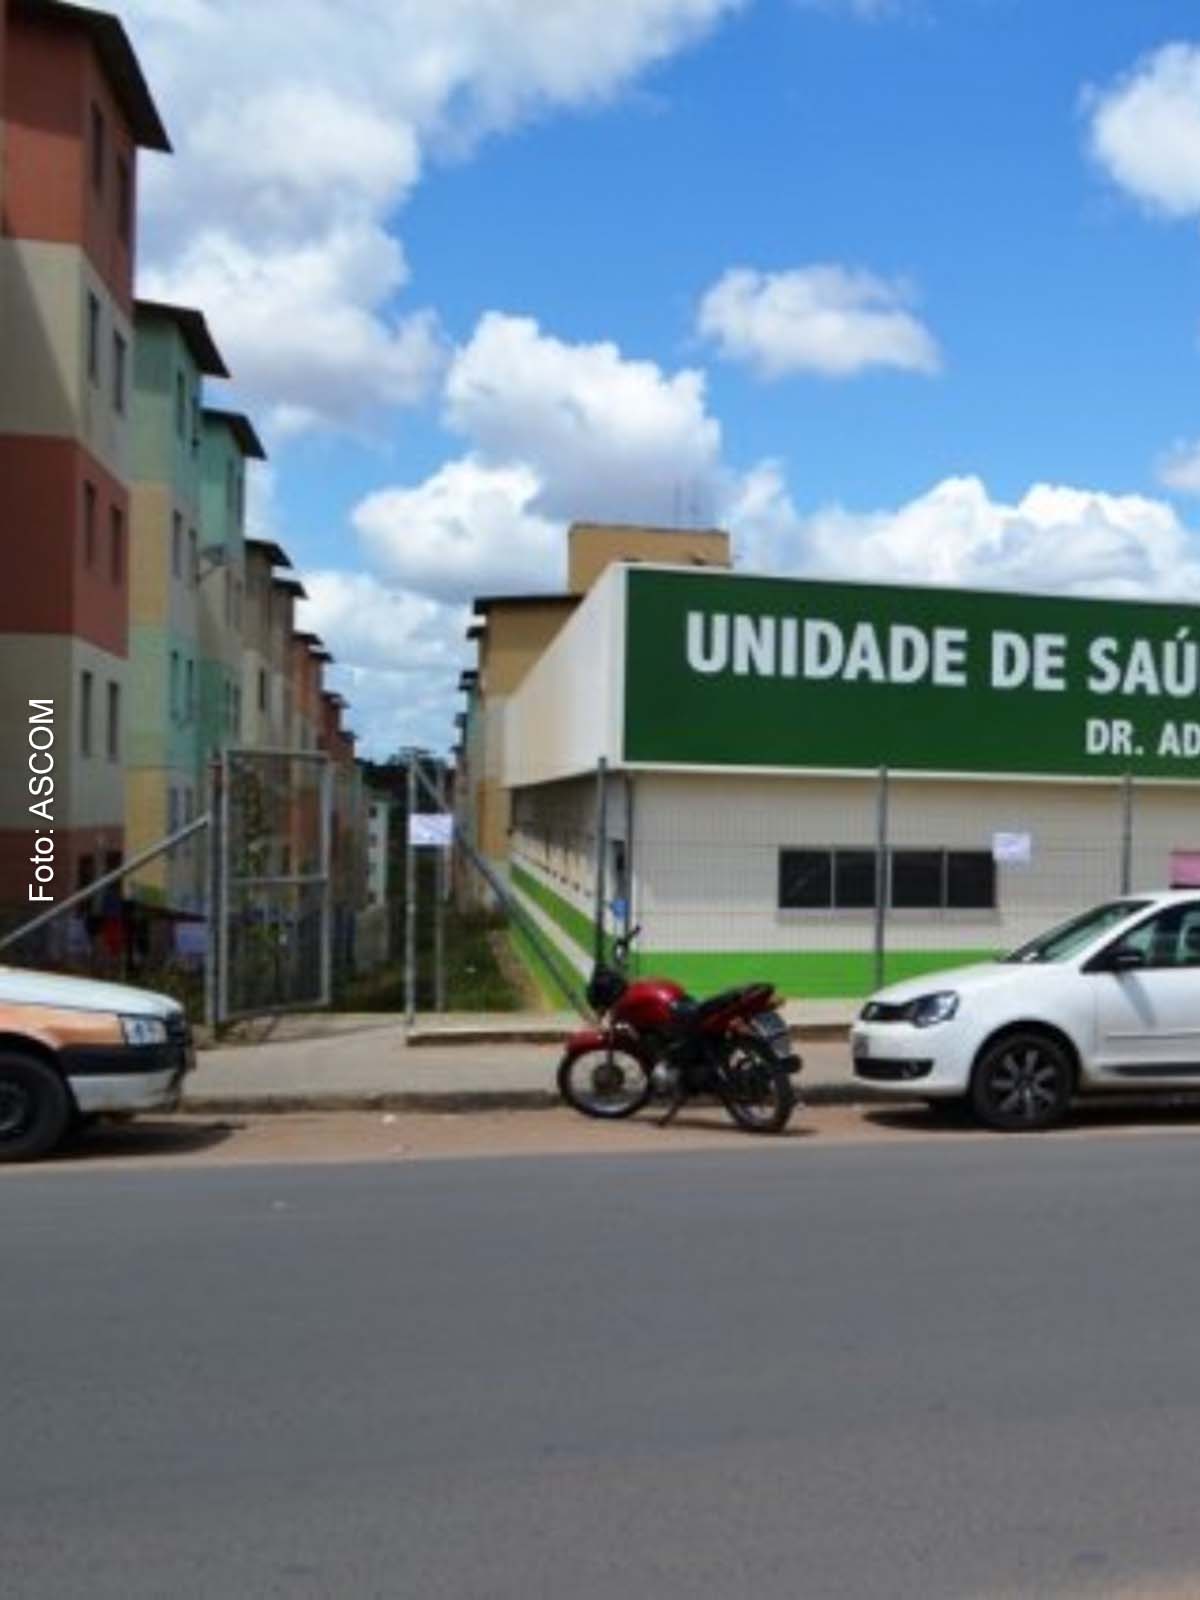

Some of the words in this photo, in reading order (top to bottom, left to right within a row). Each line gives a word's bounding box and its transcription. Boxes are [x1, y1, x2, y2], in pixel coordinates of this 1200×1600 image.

[687, 612, 968, 686] UNIDADE
[991, 632, 1067, 691] DE
[1086, 719, 1144, 756] DR.
